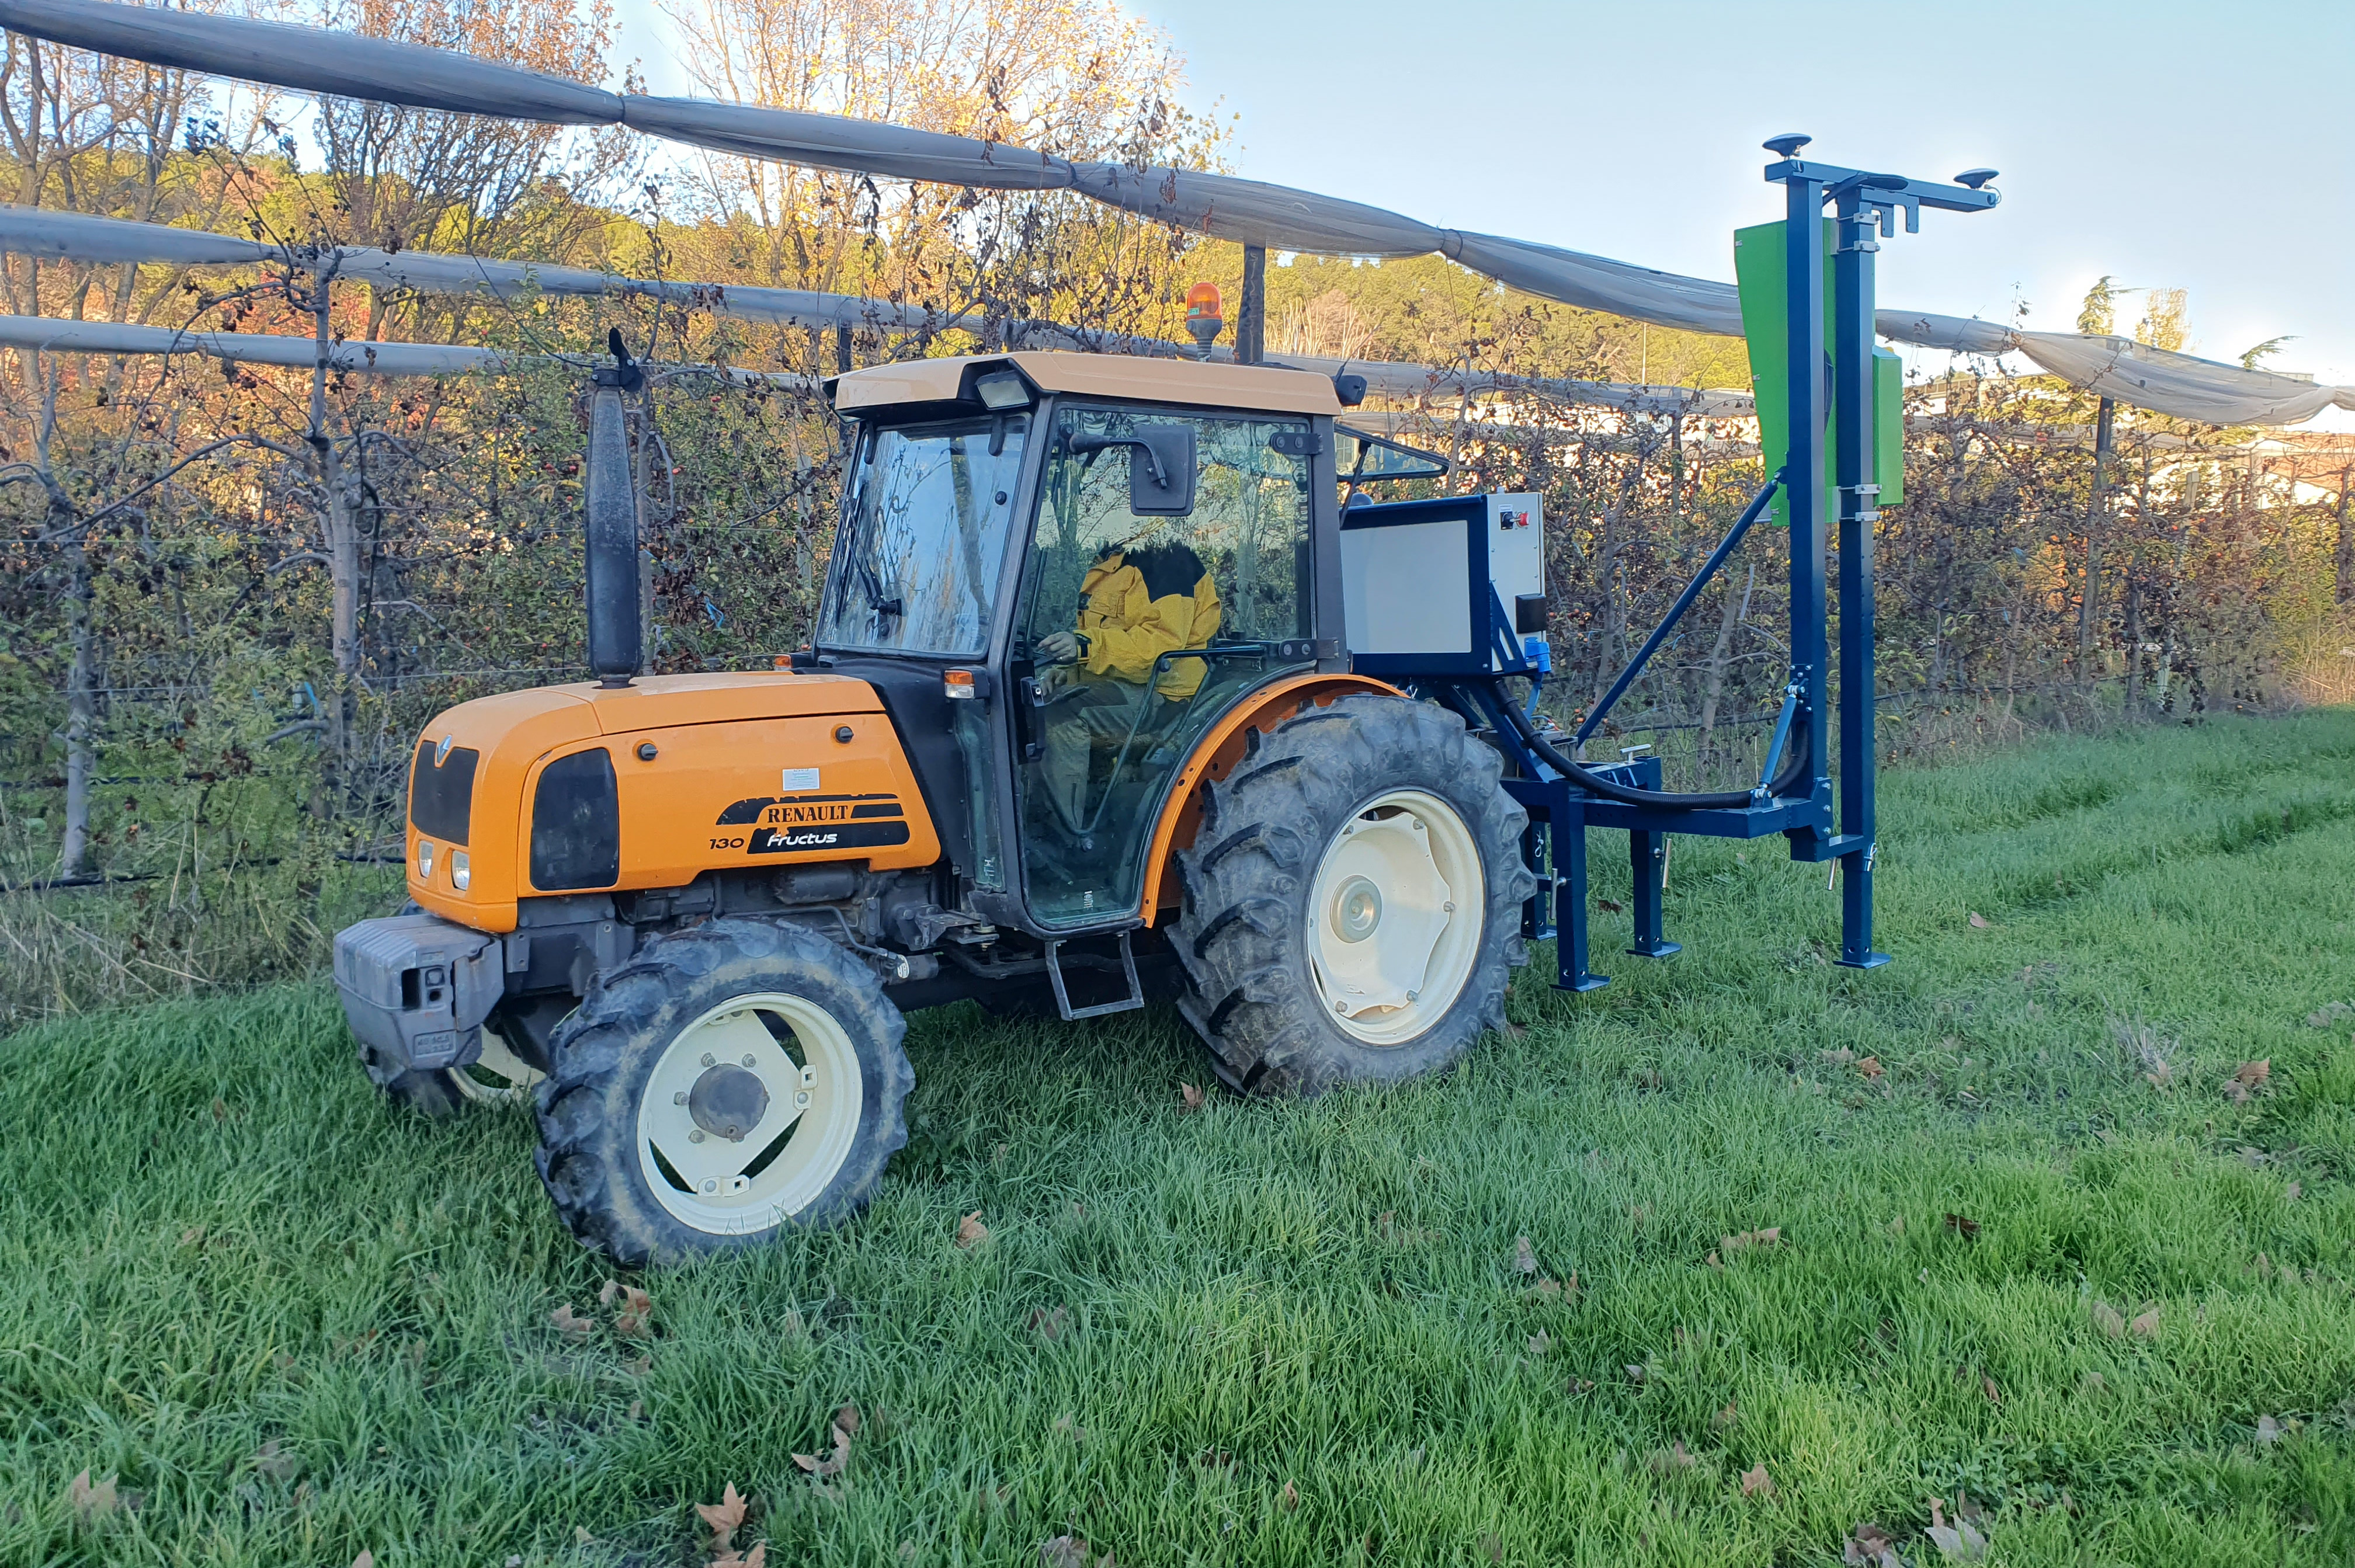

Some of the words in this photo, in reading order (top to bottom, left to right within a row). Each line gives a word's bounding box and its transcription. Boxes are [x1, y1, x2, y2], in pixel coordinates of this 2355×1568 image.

[767, 805, 849, 823] RENAULT
[709, 837, 745, 850] 130
[766, 833, 838, 847] Fructus
